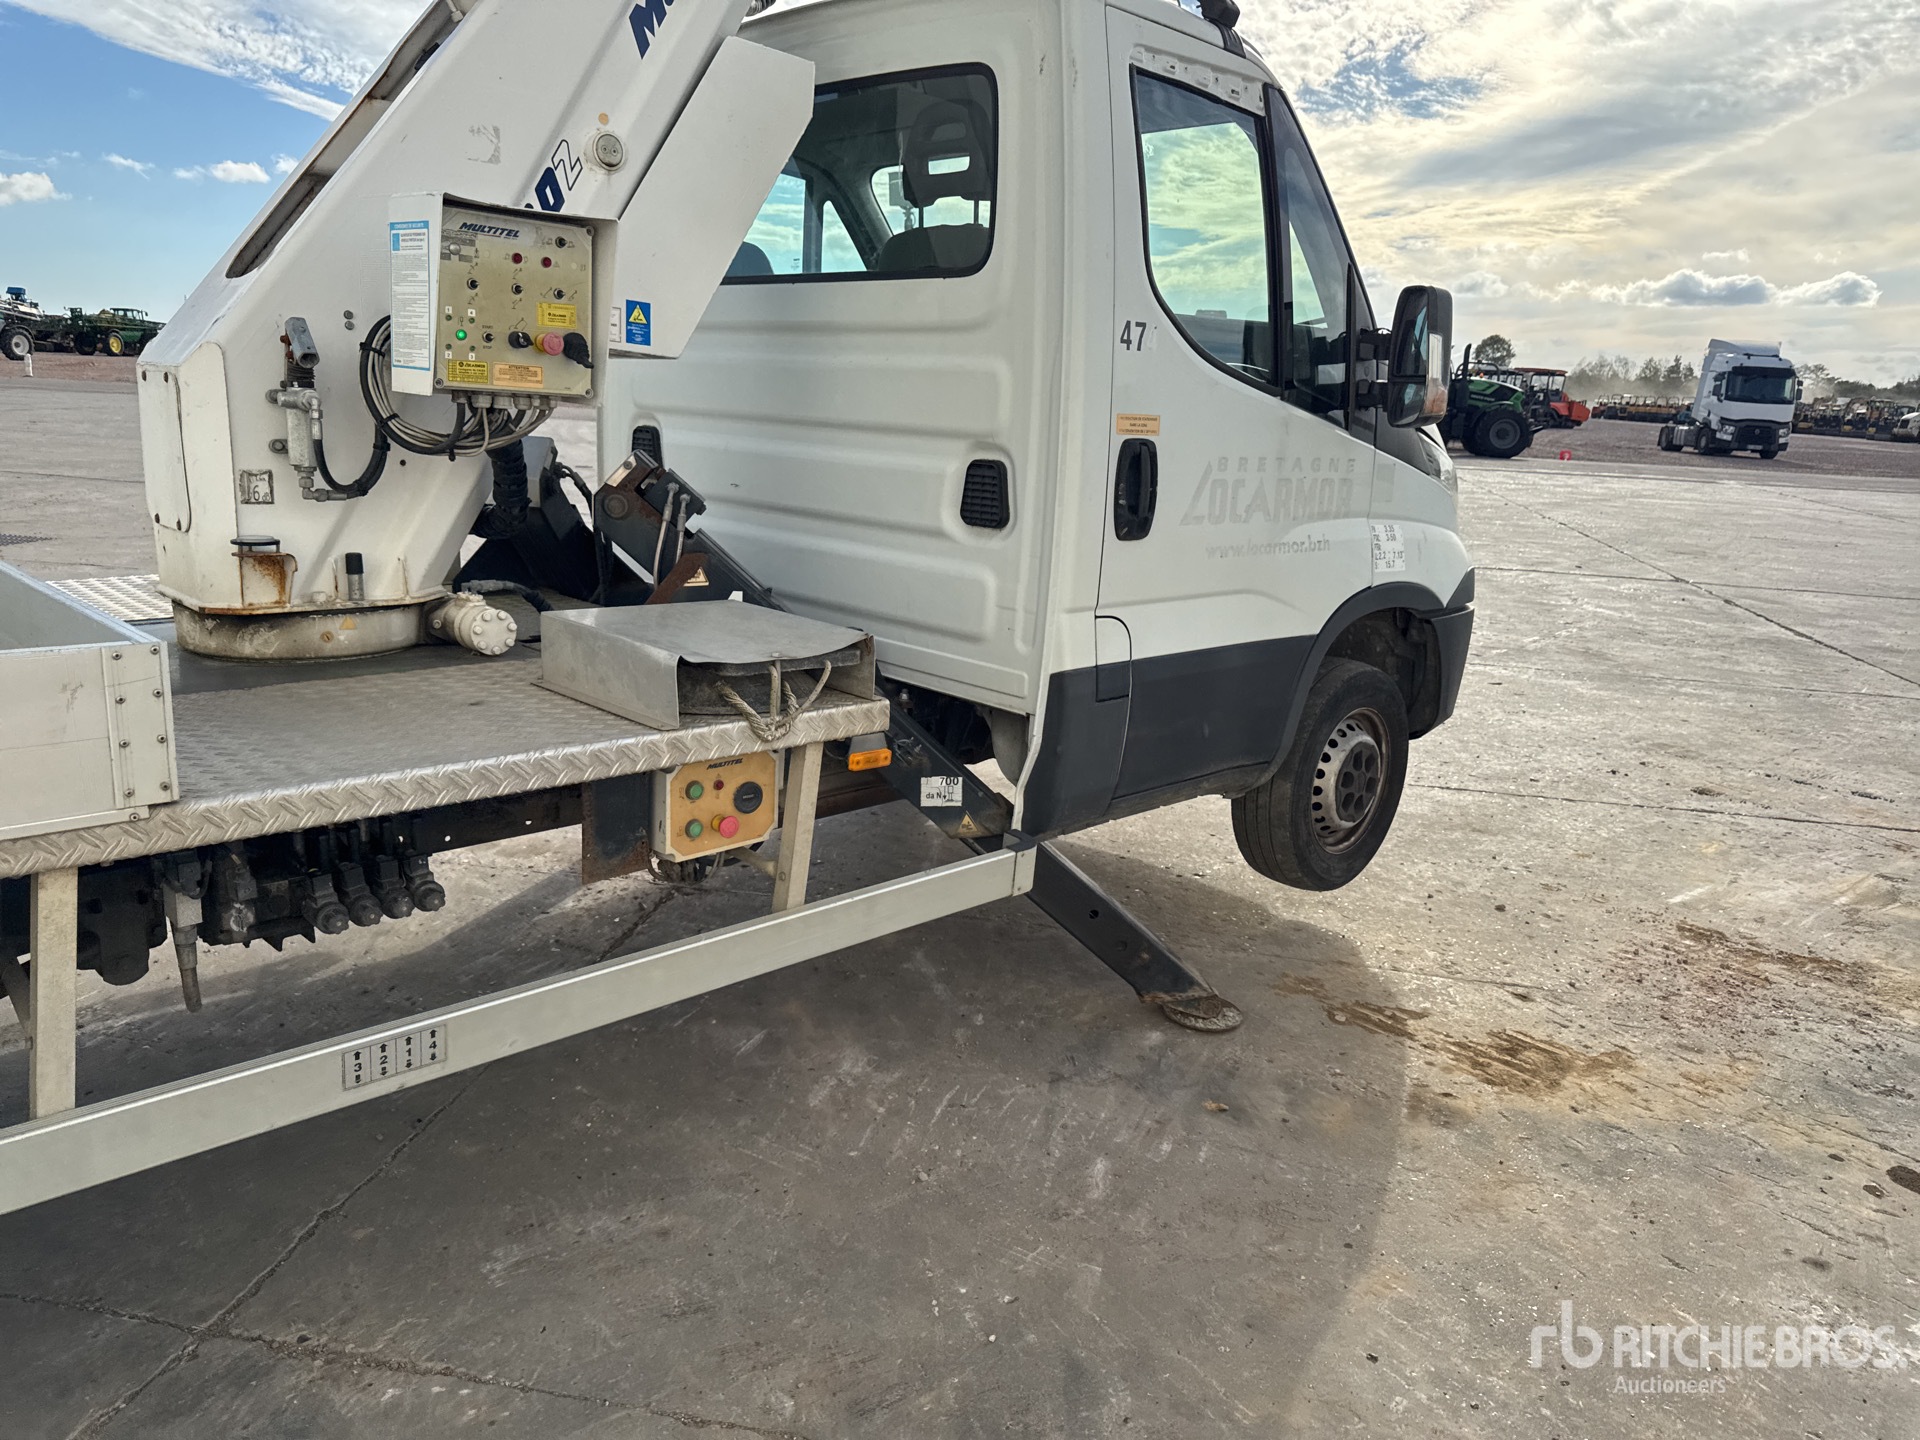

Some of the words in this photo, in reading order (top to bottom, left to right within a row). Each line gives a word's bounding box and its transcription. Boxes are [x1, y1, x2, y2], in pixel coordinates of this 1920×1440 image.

[459, 222, 520, 238] MULTITEL
[1120, 320, 1147, 352] 47
[1216, 456, 1356, 473] BRETAGNE
[1178, 461, 1354, 527] LOCARMOR
[1204, 534, 1331, 560] www.locarmor.bzh
[706, 758, 744, 770] MULTITEL
[939, 777, 959, 786] 700
[429, 1040, 437, 1049] 4
[406, 1048, 411, 1057] 1
[380, 1055, 388, 1065] 2
[354, 1062, 362, 1072] 3
